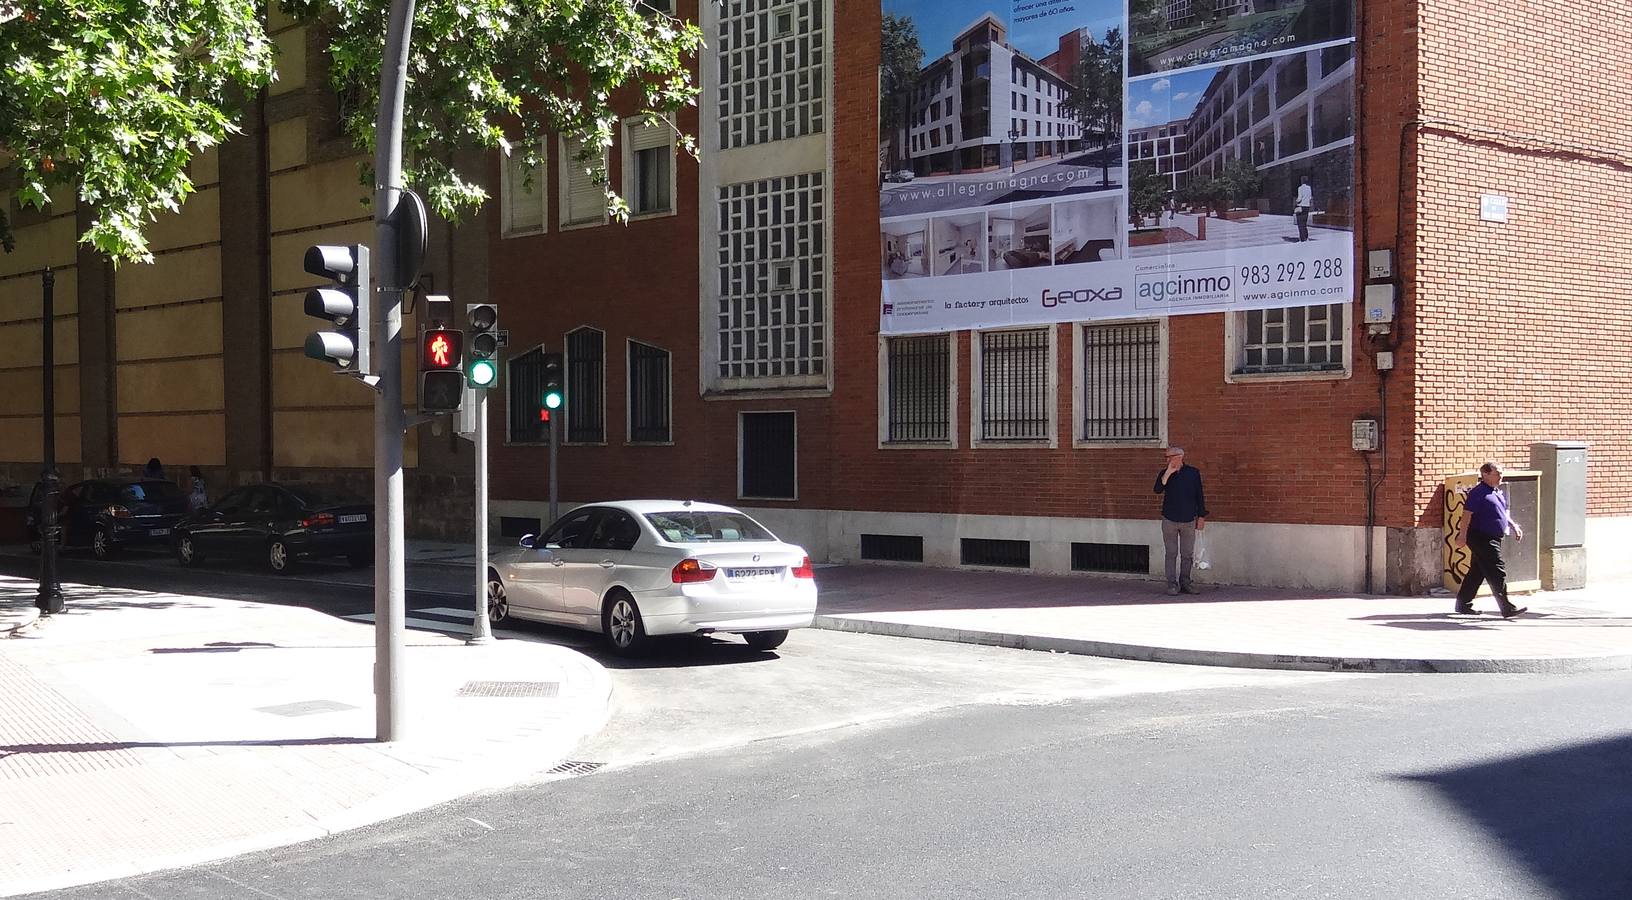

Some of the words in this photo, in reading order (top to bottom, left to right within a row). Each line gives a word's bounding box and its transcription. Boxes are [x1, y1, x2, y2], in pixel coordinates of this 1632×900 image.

[1014, 14, 1038, 23] mayores
[1159, 34, 1296, 65] www.allegramagna.com
[899, 168, 1089, 201] www.allegramagna.com
[1241, 264, 1270, 286] 983
[1277, 261, 1306, 282] 292
[1313, 257, 1343, 280] 288
[1139, 274, 1231, 301] agcinmo
[1243, 286, 1344, 301] www.agcinmo.com
[944, 301, 952, 309] la
[954, 300, 986, 309] factory
[988, 296, 1029, 307] arquitectos
